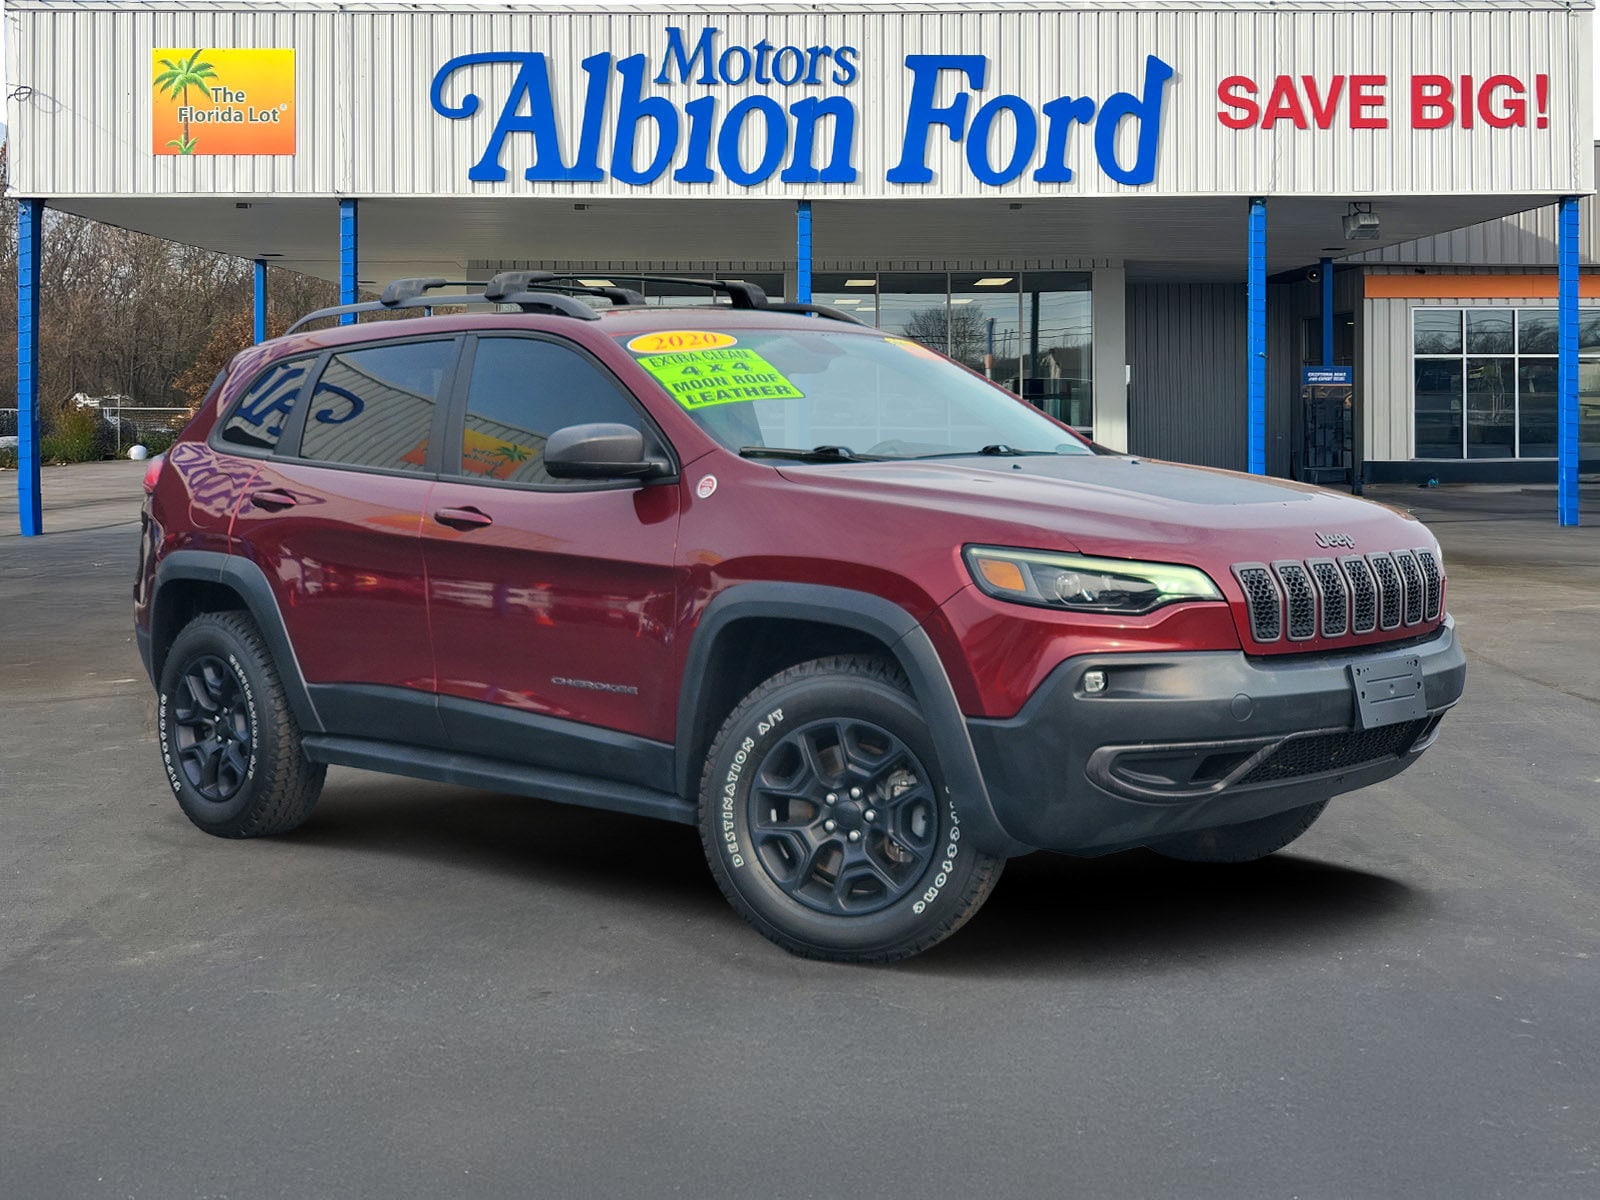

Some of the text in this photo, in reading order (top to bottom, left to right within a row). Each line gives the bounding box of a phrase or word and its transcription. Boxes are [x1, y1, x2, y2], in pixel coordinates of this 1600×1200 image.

[653, 27, 857, 86] Motors
[210, 86, 246, 103] The
[1217, 74, 1548, 129] SAVE BIG!
[178, 106, 279, 123] Florida Lot
[430, 51, 1174, 186] Albion Ford
[654, 332, 718, 350] 2020
[649, 349, 752, 368] EXTRA CLEAN
[672, 373, 778, 393] MOON ROOF
[686, 386, 791, 405] LEATHER
[1315, 531, 1355, 549] Jeep
[551, 676, 638, 695] CHEROKEE
[722, 708, 785, 868] DESTINATION A/T
